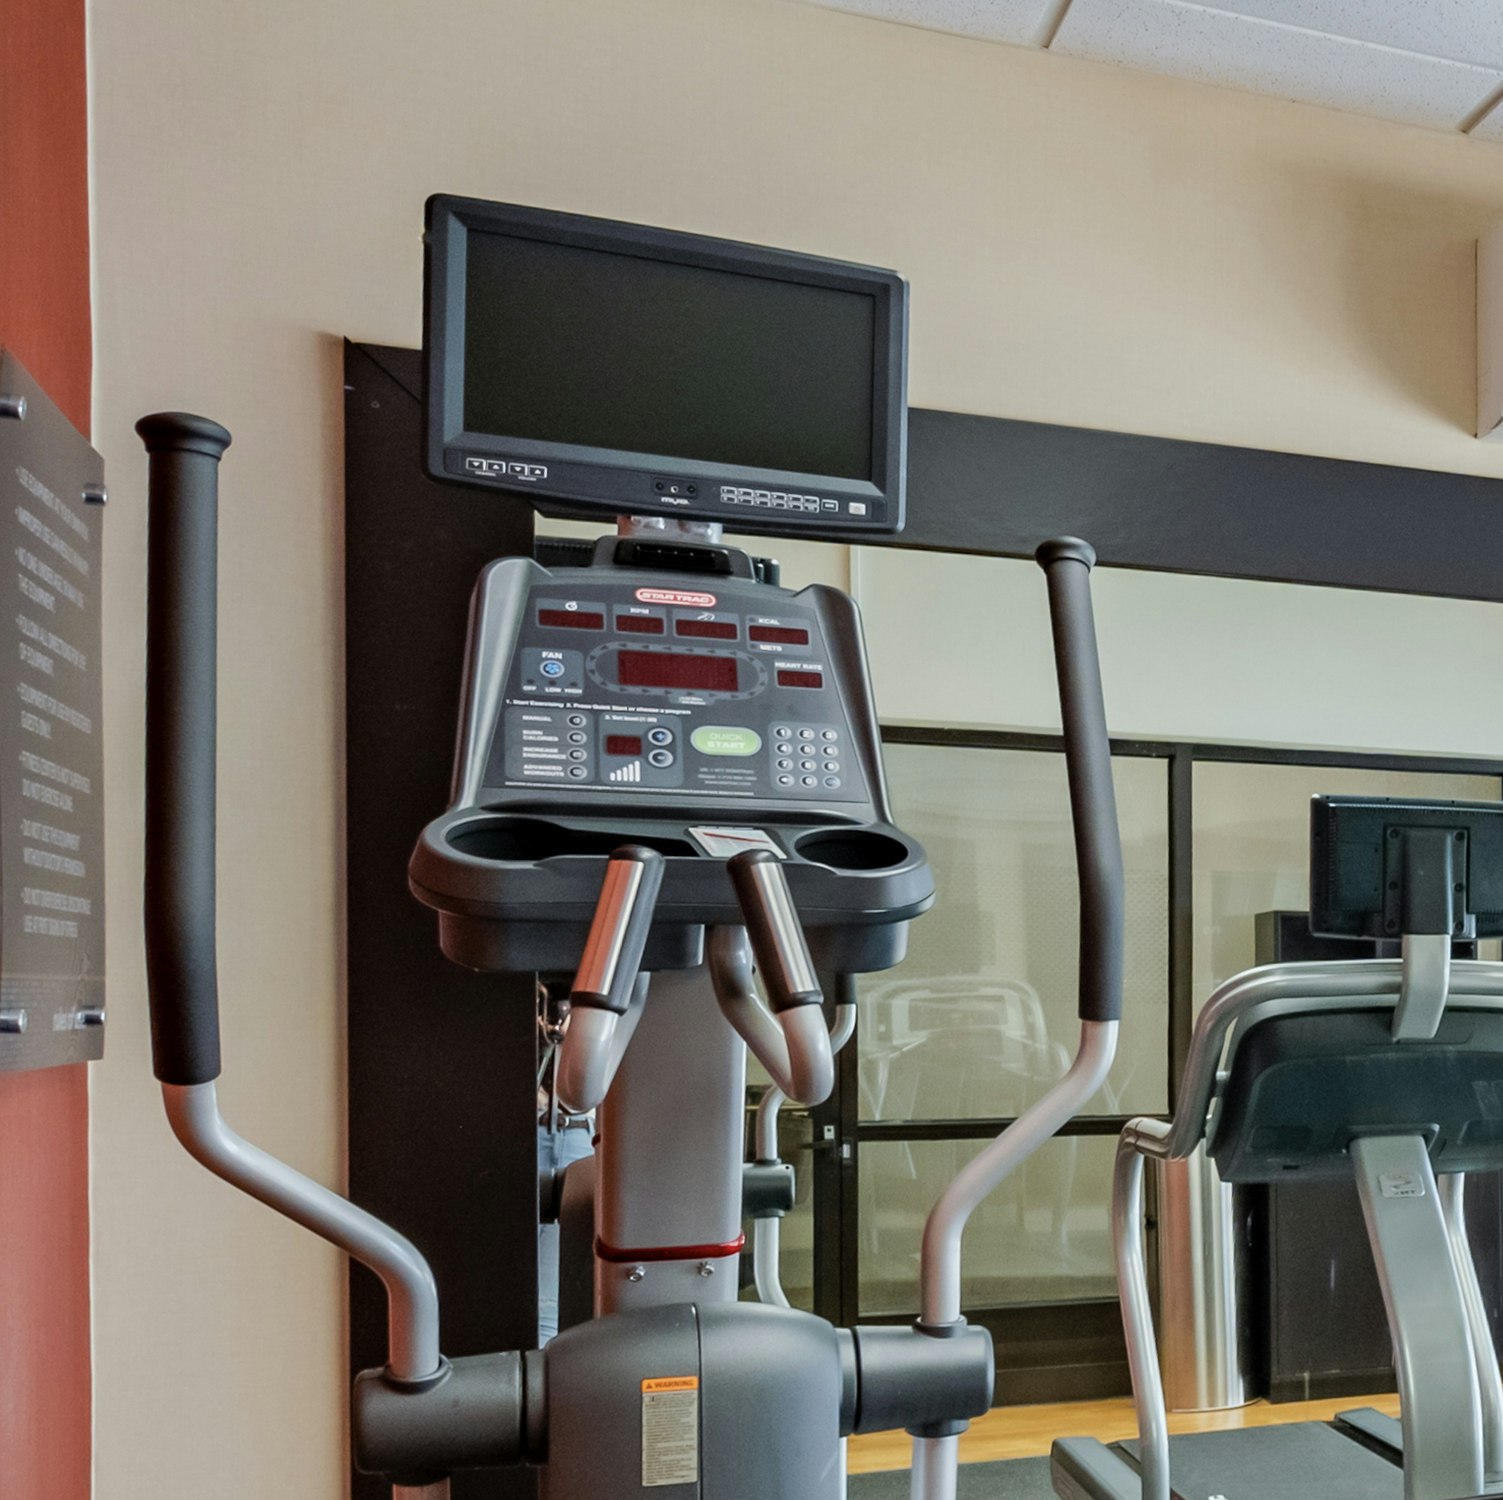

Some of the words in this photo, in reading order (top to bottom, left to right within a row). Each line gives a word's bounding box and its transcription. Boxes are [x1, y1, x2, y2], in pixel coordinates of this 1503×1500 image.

[639, 592, 674, 601] STAR
[676, 595, 710, 603] TRAC
[542, 651, 562, 659] FAN
[775, 661, 801, 669] HEART
[709, 732, 744, 741] QUICK
[707, 741, 745, 749] START
[655, 1380, 694, 1388] WARNING
